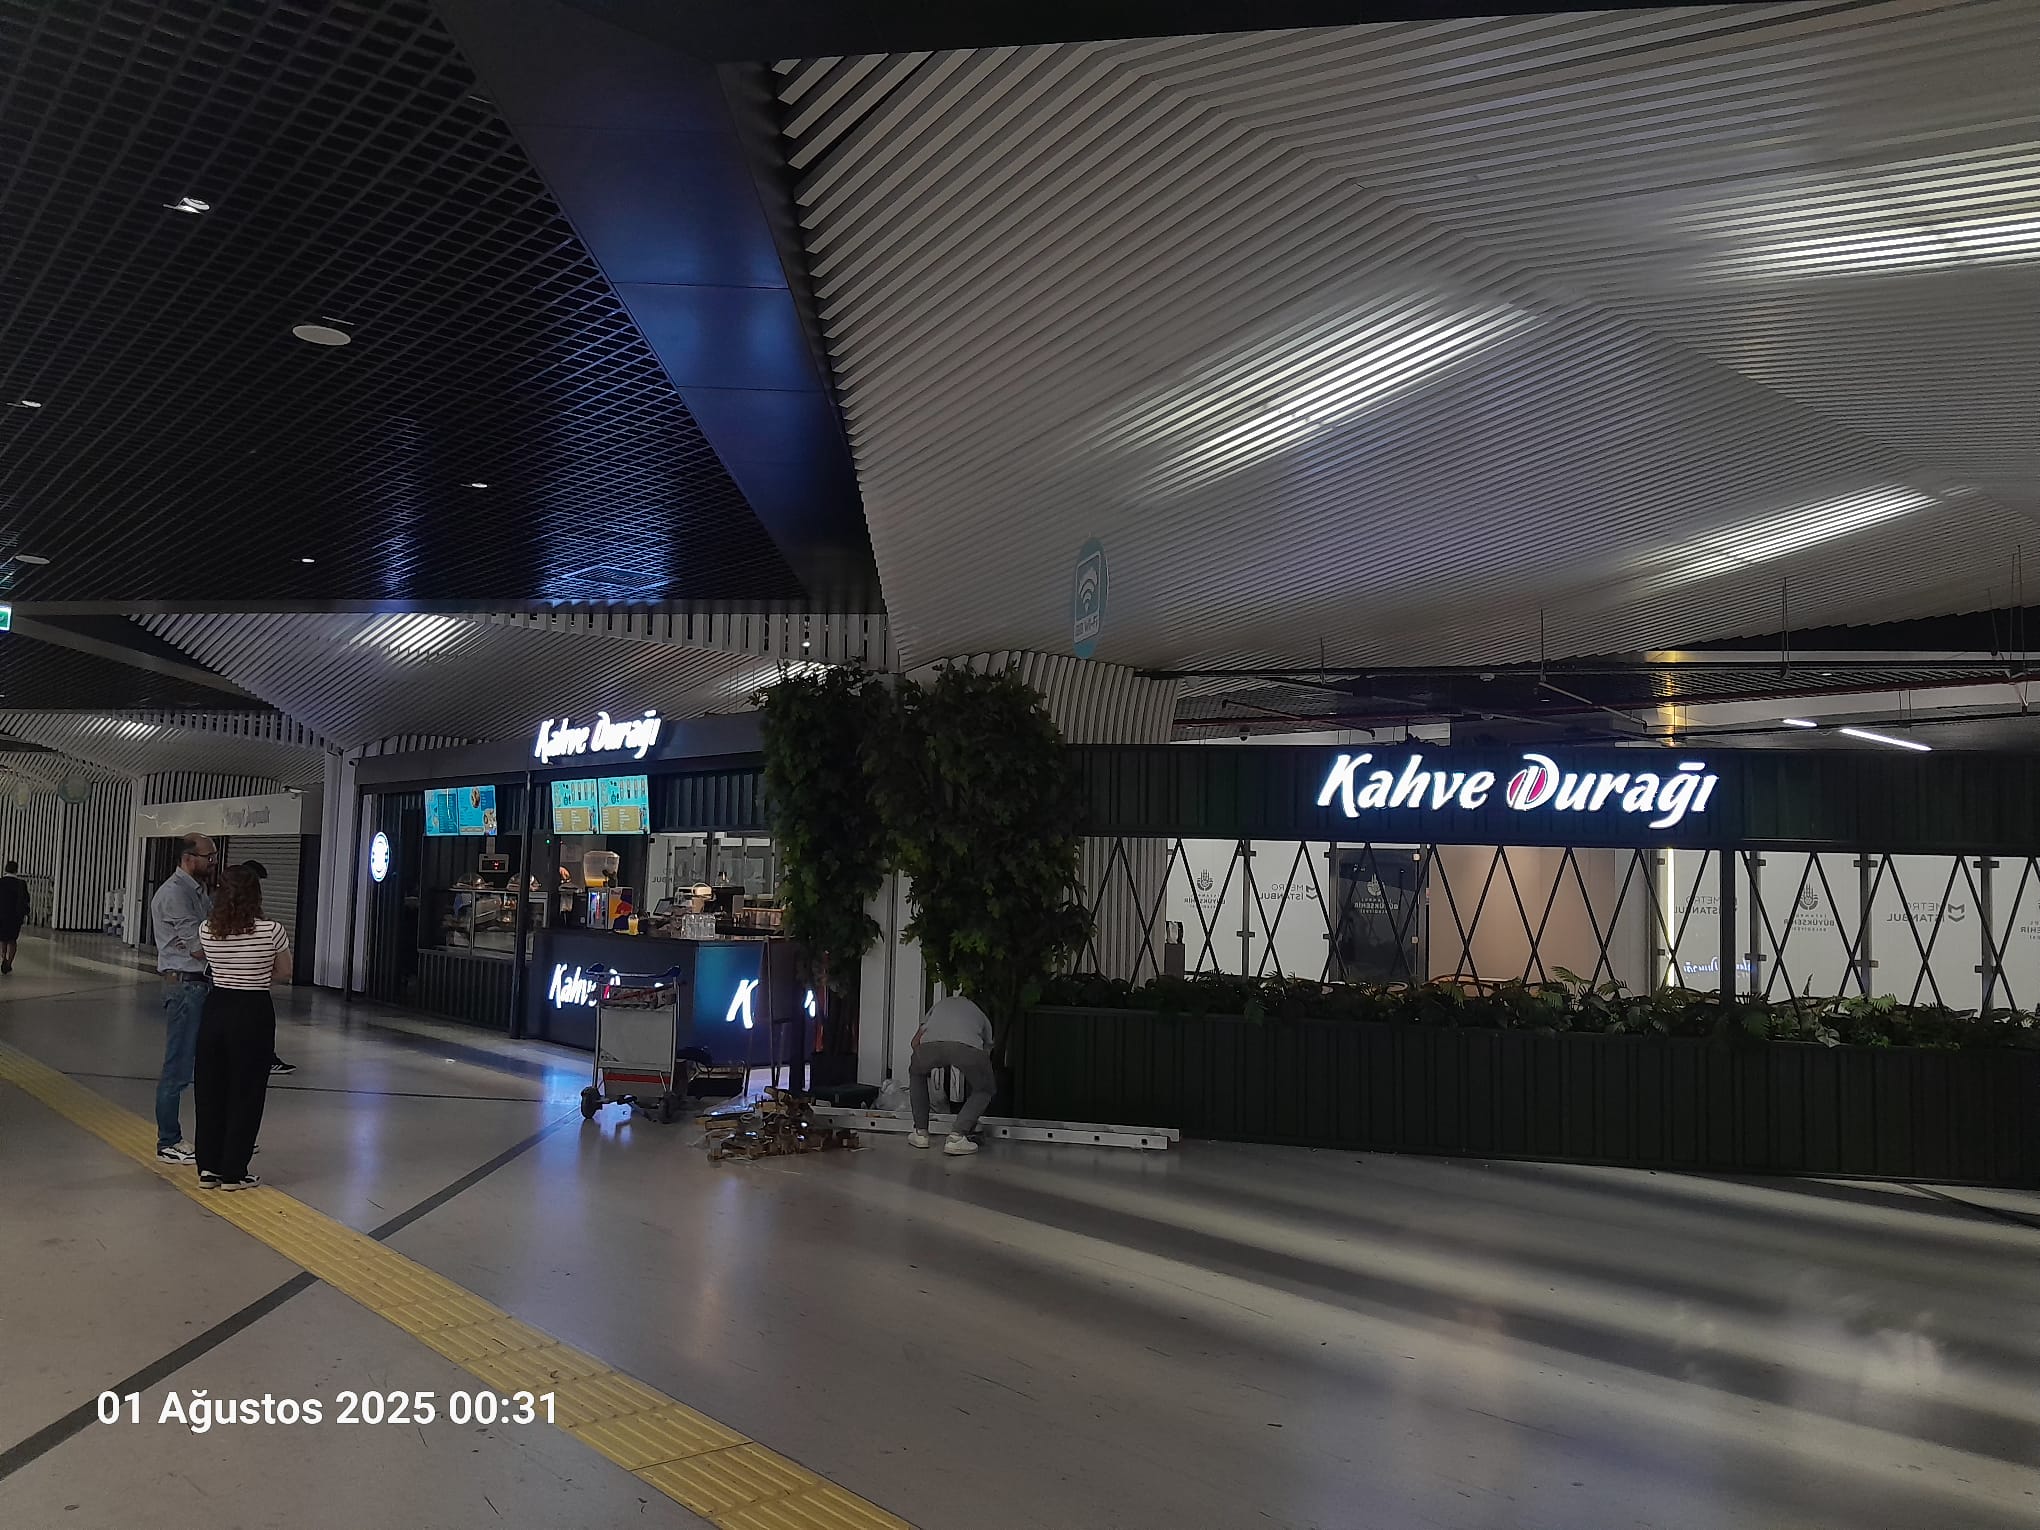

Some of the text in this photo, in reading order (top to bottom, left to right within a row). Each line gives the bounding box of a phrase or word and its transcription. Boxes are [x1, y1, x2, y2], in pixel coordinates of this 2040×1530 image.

[535, 709, 662, 764] Kahve Durağı
[1317, 753, 1718, 828] Kahve Durağı
[726, 979, 759, 1029] K
